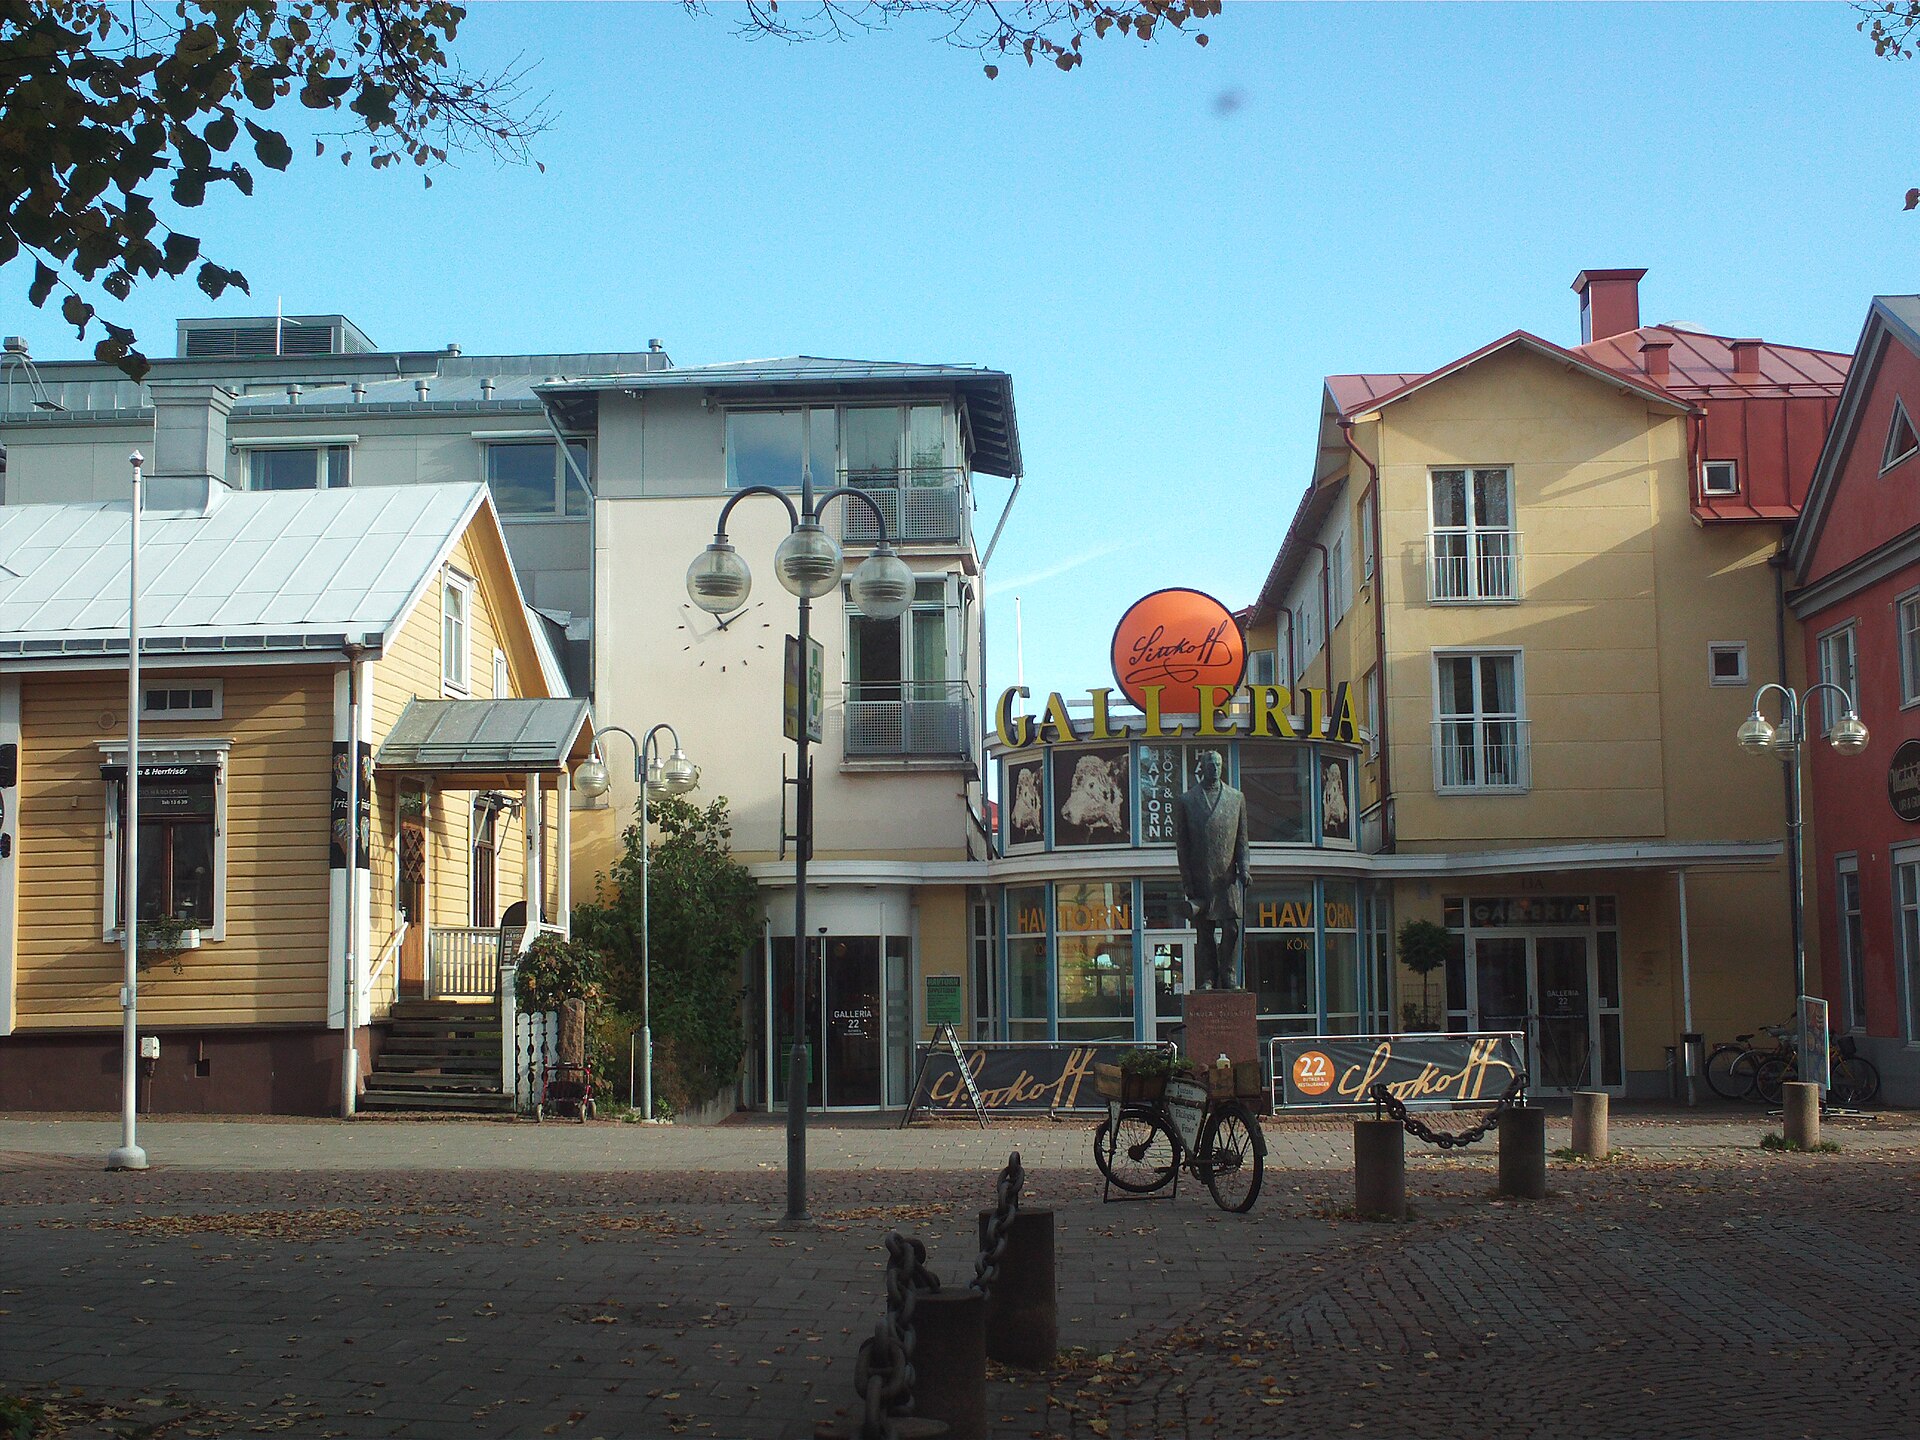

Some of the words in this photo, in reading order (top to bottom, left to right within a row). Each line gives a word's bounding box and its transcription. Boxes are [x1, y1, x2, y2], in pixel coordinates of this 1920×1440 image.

[996, 682, 1363, 747] GALLERIA
[1286, 936, 1311, 951] KÖK
[1546, 989, 1579, 997] GALLERIA
[1558, 997, 1569, 1005] 22
[833, 1009, 873, 1019] GALLERIA
[847, 1019, 860, 1029] 22
[1299, 1056, 1327, 1077] 22
